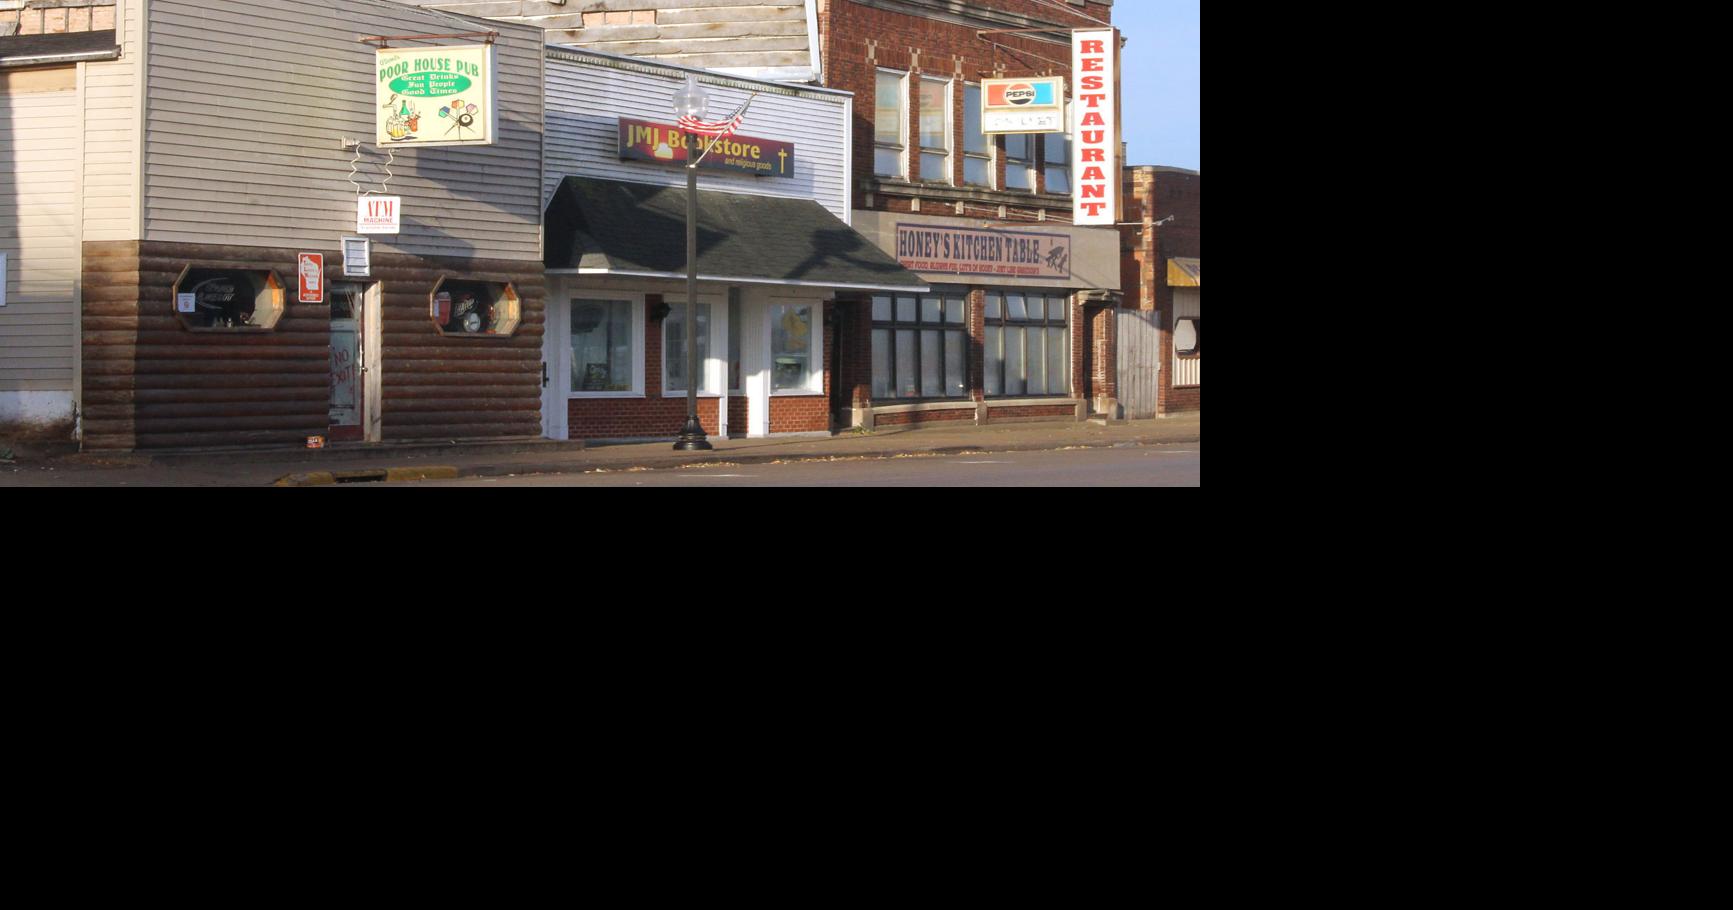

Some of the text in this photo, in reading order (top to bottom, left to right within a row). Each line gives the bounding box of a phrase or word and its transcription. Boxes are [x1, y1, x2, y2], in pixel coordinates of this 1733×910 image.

[380, 61, 408, 82] POOR
[414, 58, 450, 71] HOUSE
[456, 60, 479, 77] PUB
[1005, 90, 1035, 98] PEPSI
[627, 124, 660, 151] JMJ
[1080, 39, 1106, 217] RESTAURANT
[899, 230, 1040, 264] HONEY'S KITCHEN TABLE
